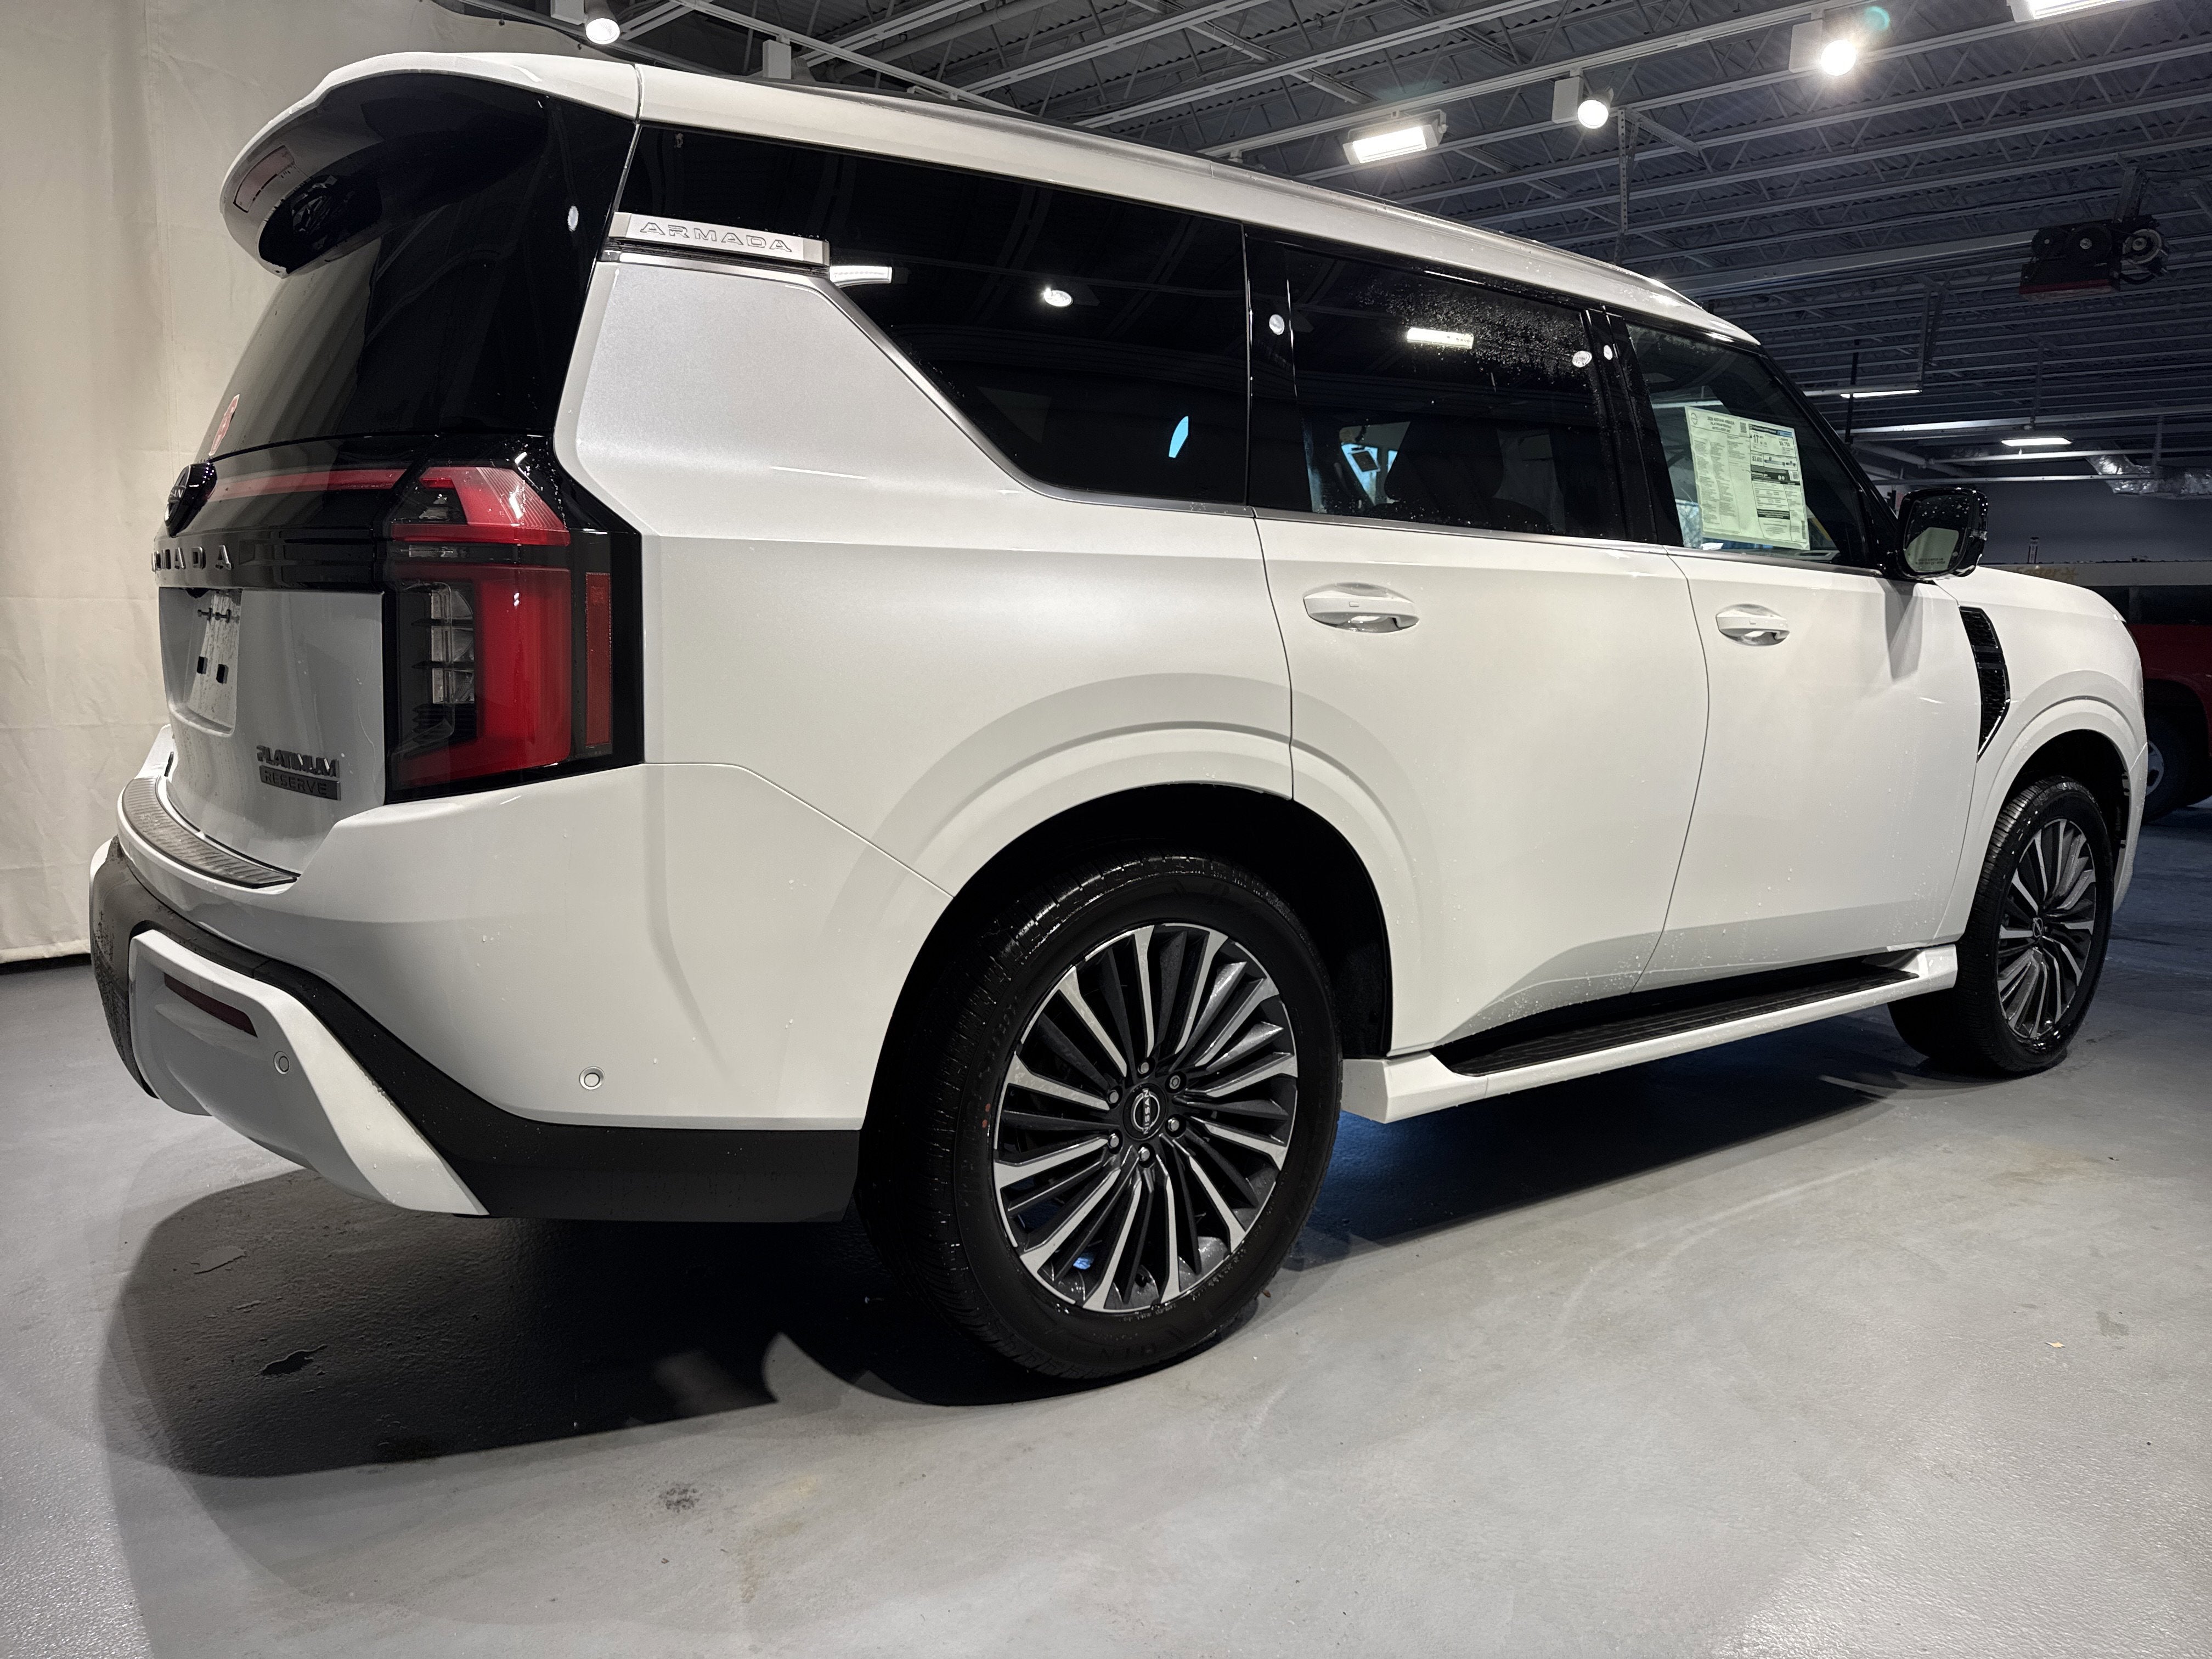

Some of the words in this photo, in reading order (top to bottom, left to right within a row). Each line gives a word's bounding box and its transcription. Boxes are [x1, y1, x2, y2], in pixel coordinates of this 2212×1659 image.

[640, 222, 793, 253] ARMADA
[1753, 434, 1759, 444] 17
[151, 545, 232, 571] ADA
[256, 744, 340, 778] PLATINUM
[264, 769, 328, 795] RESERVE
